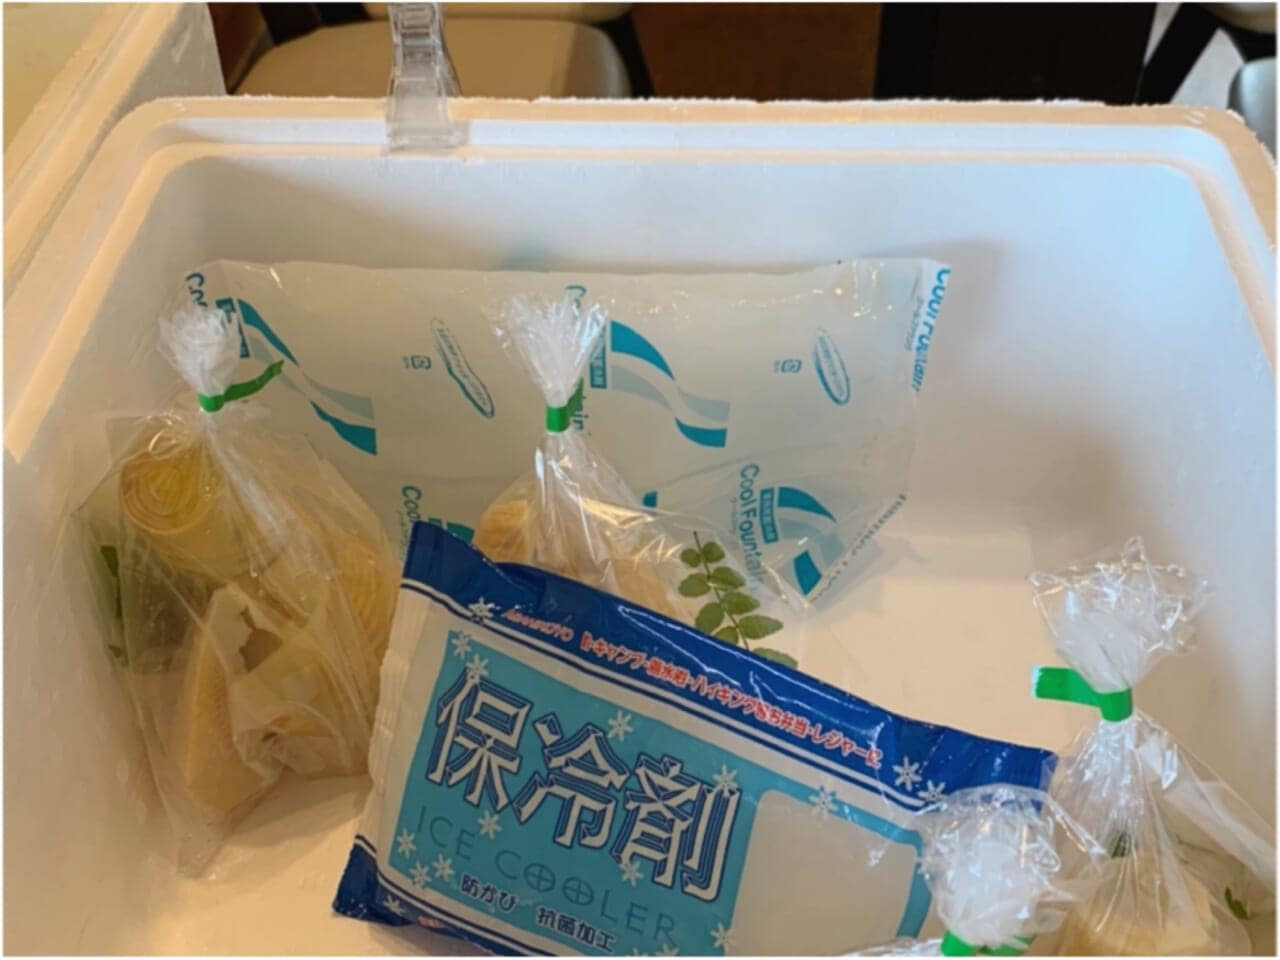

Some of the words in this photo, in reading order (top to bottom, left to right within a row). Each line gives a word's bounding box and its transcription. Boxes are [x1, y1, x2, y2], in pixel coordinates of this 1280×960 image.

[417, 806, 475, 861] ICE
[495, 850, 675, 946] COOLER
[426, 670, 743, 903] 保冷剤
